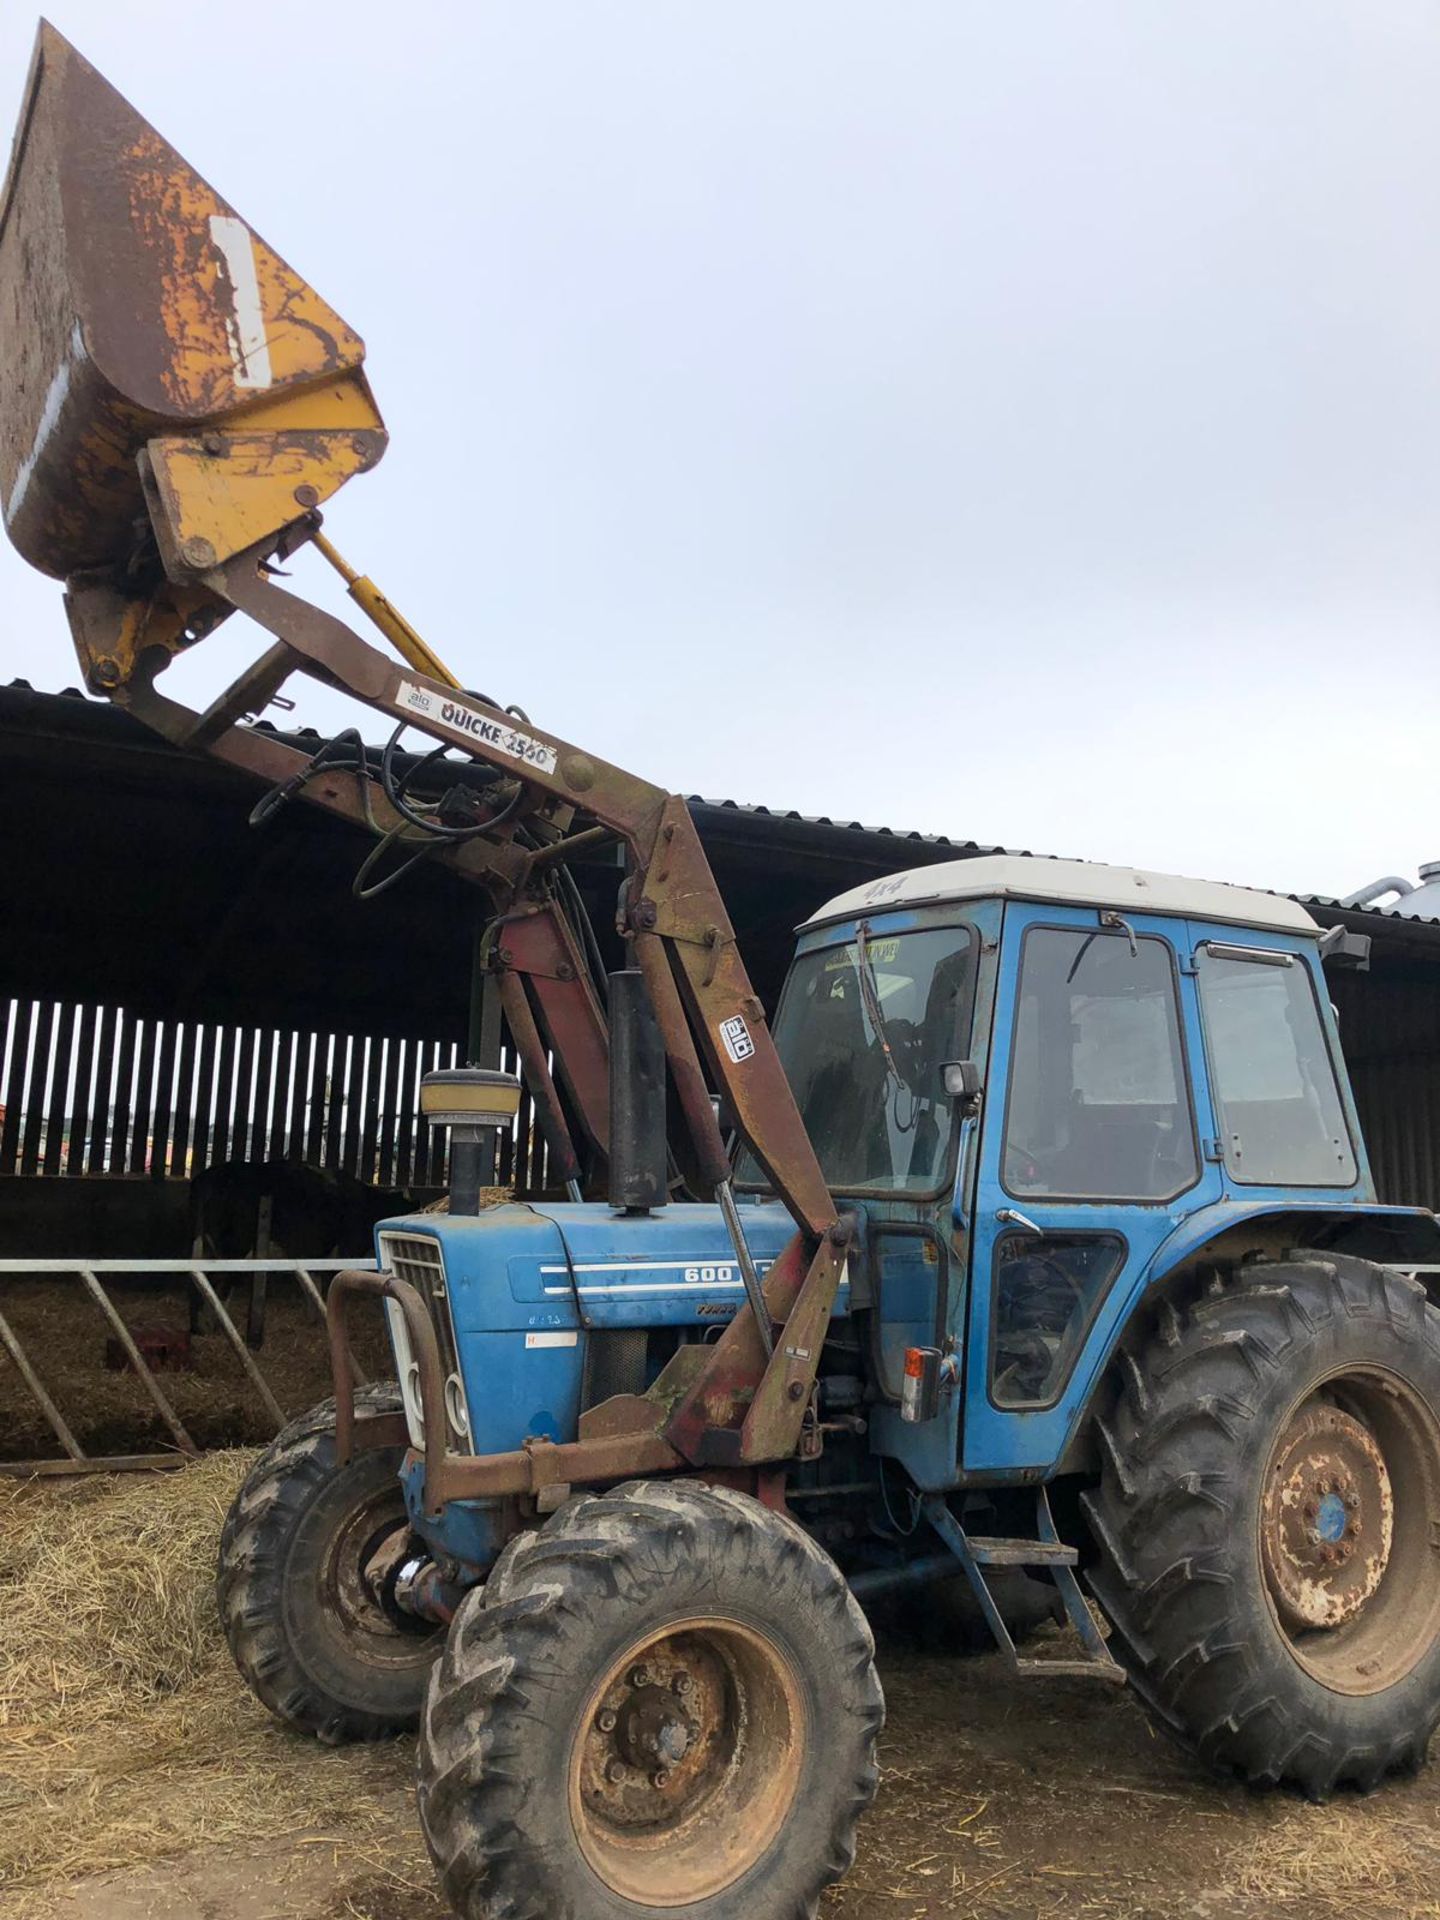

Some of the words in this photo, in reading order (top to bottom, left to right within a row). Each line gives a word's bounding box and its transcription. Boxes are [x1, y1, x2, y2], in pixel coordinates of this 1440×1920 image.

[441, 702, 502, 744] QUICKE
[725, 1020, 750, 1058] alo
[684, 1267, 732, 1282] 600
